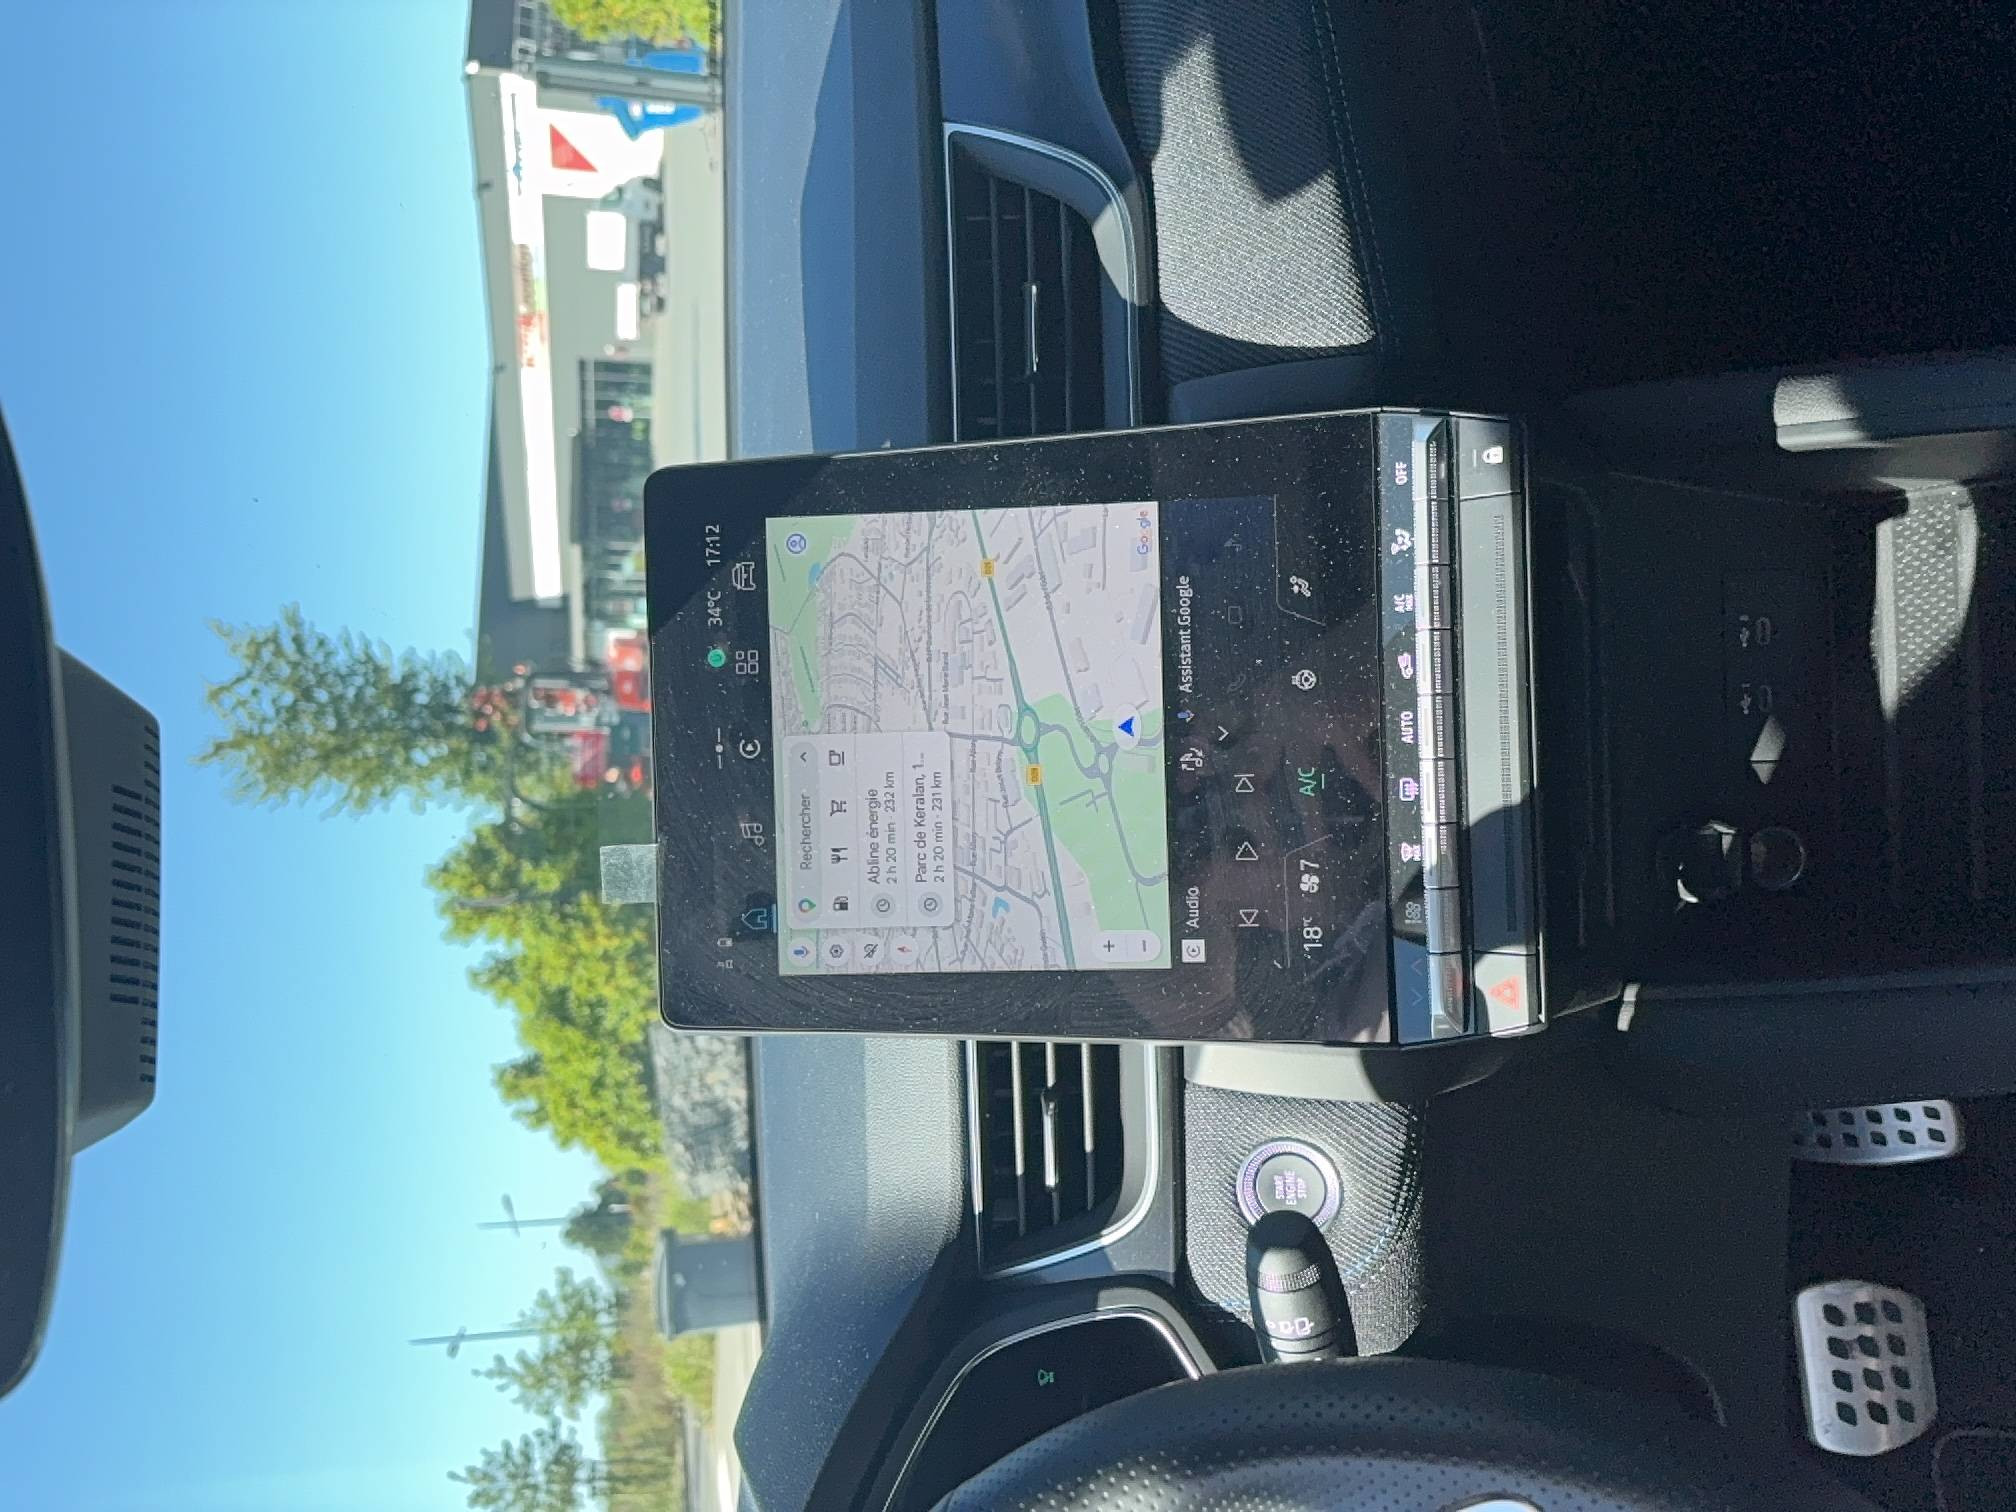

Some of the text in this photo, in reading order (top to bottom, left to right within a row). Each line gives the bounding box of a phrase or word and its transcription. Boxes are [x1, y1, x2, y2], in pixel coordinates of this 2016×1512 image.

[1396, 462, 1408, 486] OFF
[1136, 511, 1151, 555] Gogle
[706, 524, 722, 626] 34°C 17:12
[1394, 595, 1406, 614] A/C
[1176, 575, 1193, 692] Assistant Google
[1400, 710, 1414, 744] AUTO
[930, 772, 942, 788] km
[1297, 766, 1316, 797] A/C
[912, 774, 926, 827] Keralan,
[932, 792, 942, 811] 231
[799, 794, 812, 870] Rechercher
[864, 789, 881, 884] Abline énergie
[884, 772, 897, 884] 2 h 20 min 232 km
[914, 832, 926, 848] de
[932, 822, 943, 842] min
[914, 853, 927, 882] Parc
[932, 846, 944, 861] 20
[1300, 859, 1320, 870] 7
[1186, 887, 1200, 928] Audio
[1284, 1170, 1296, 1205] ENGINE
[1296, 1177, 1307, 1199] STOP
